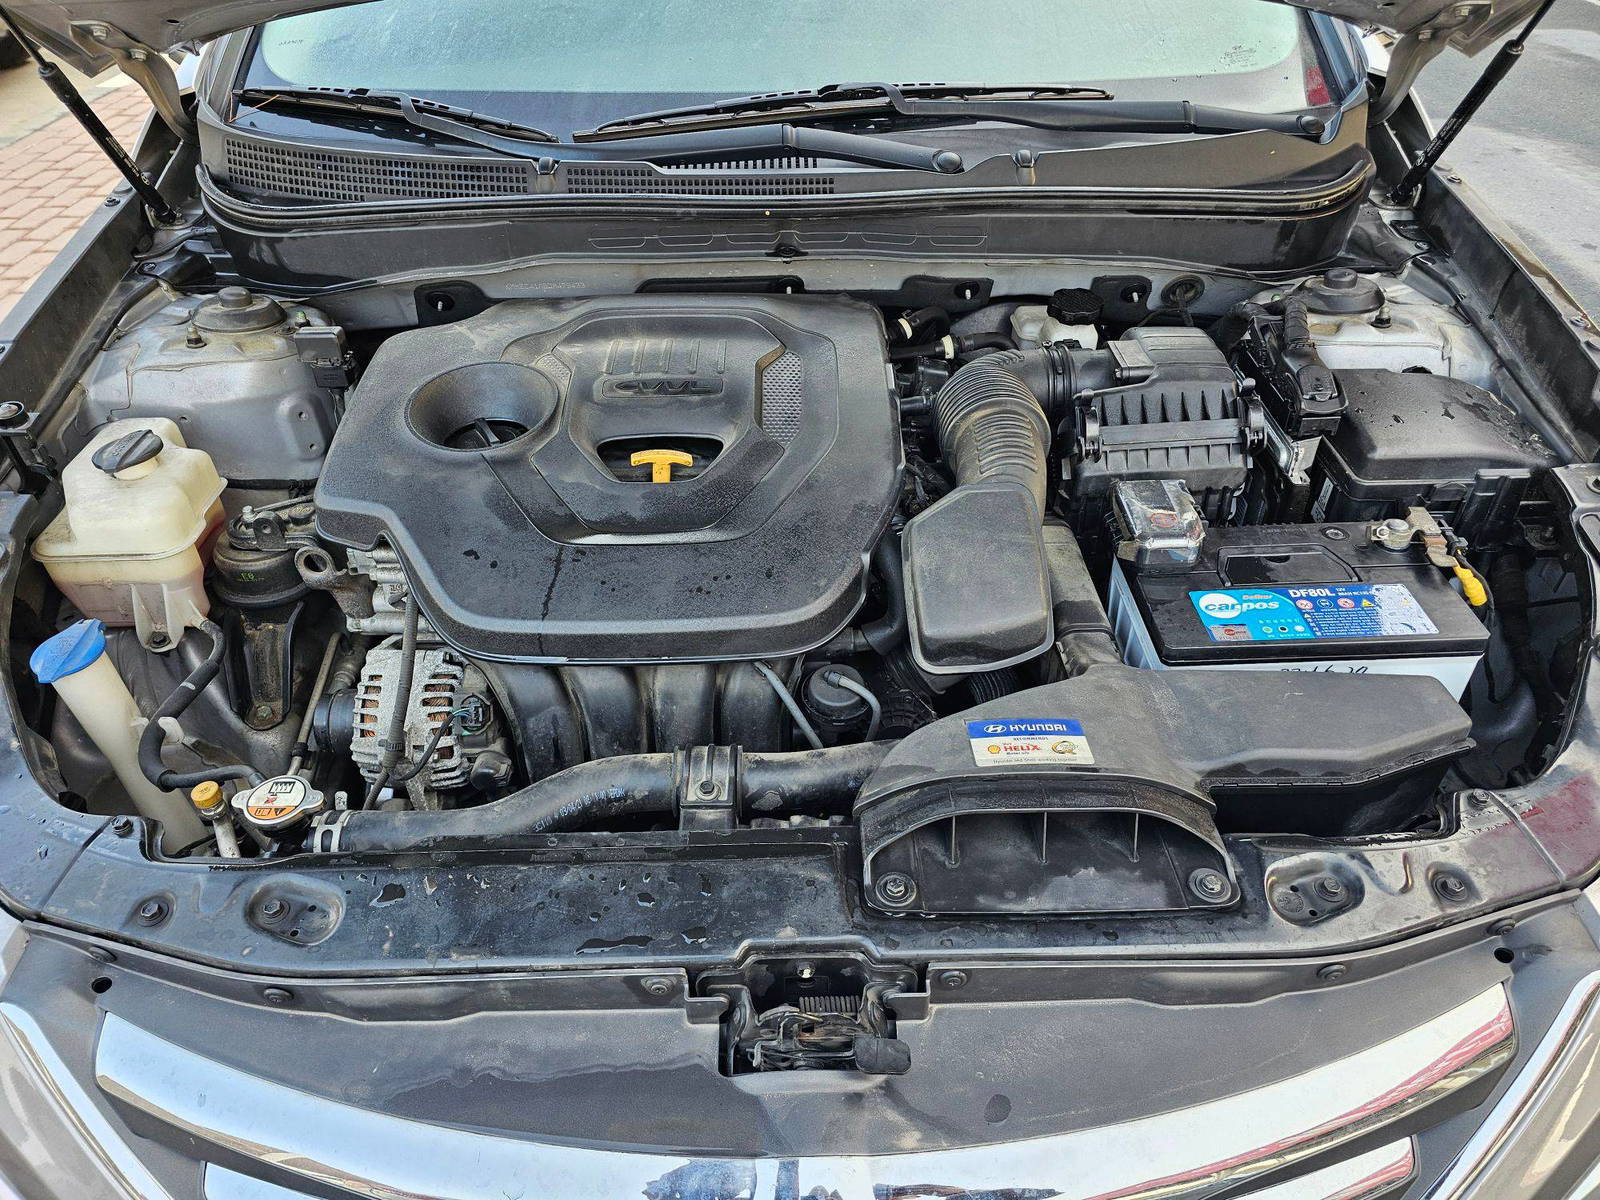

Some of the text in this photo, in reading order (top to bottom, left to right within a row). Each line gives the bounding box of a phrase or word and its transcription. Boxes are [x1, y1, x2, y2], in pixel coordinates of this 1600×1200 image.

[1288, 588, 1336, 598] DF80L
[1204, 601, 1280, 613] carpos
[1009, 723, 1067, 732] HYUNDAI
[1003, 744, 1041, 752] HELIX
